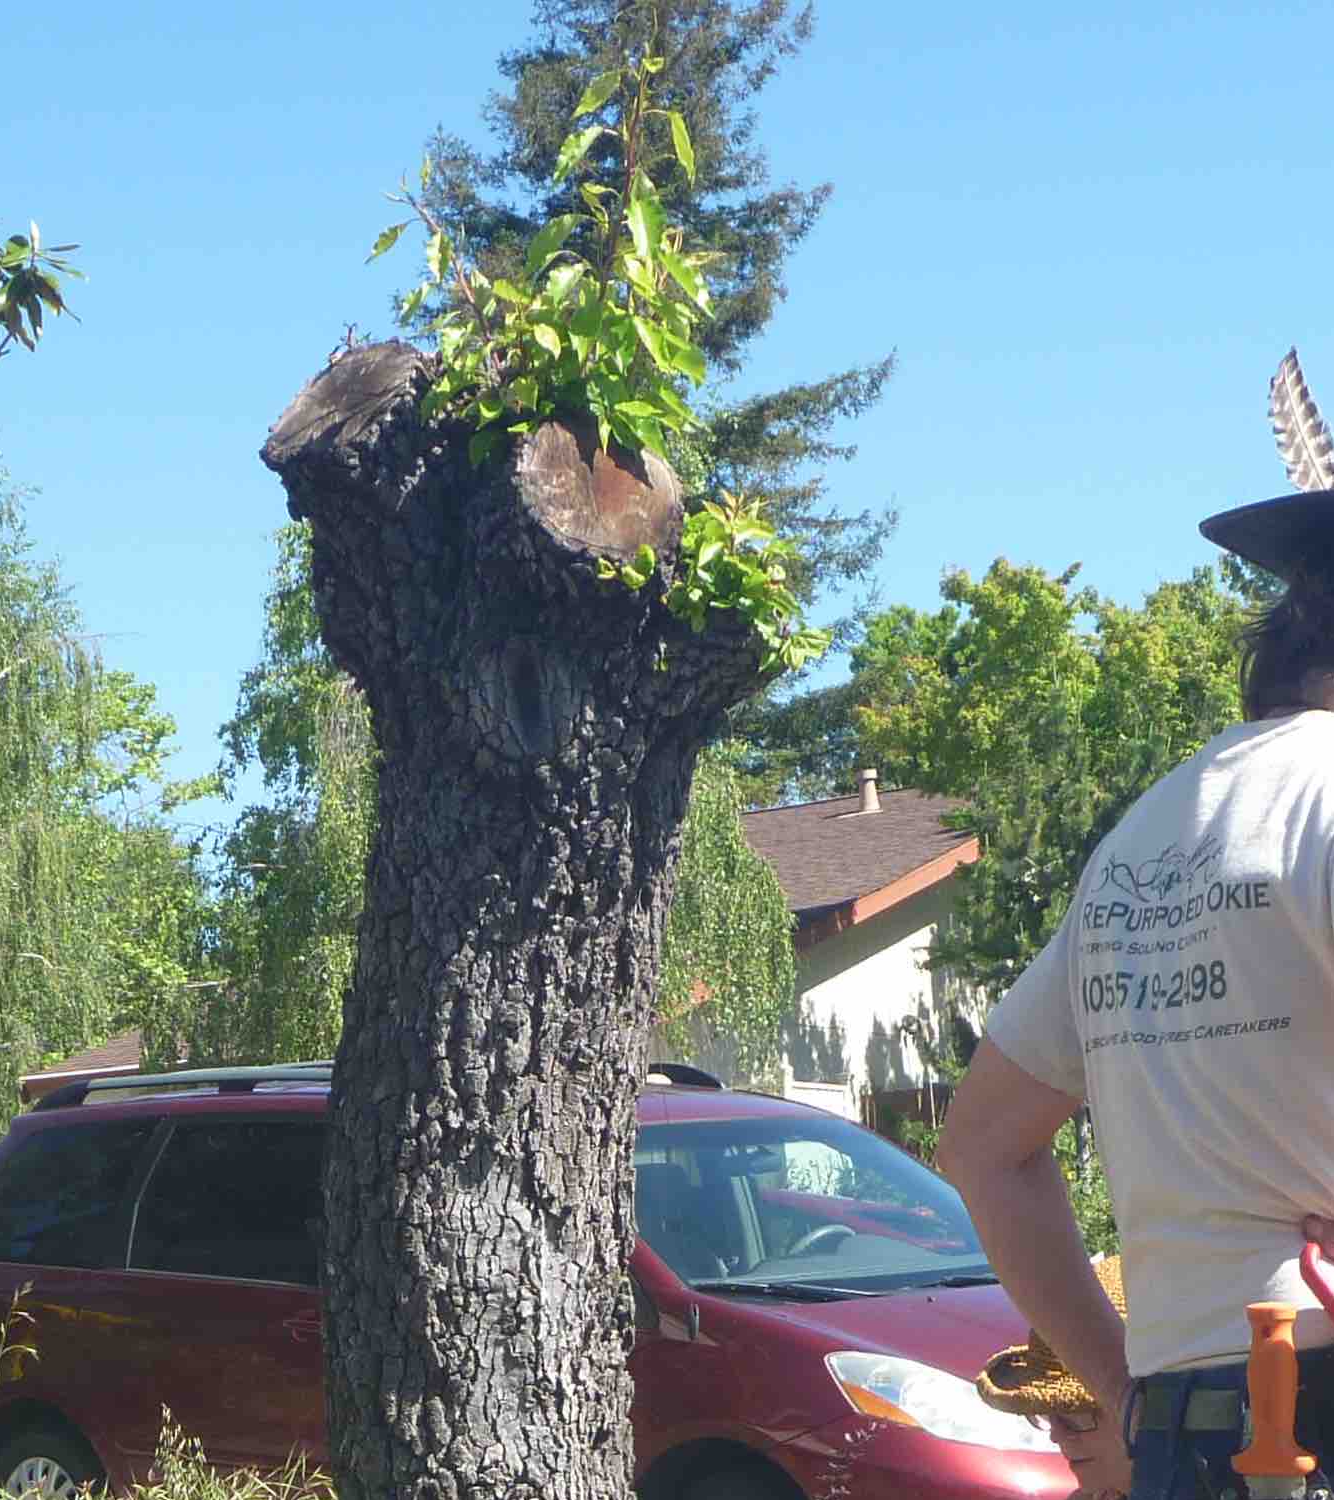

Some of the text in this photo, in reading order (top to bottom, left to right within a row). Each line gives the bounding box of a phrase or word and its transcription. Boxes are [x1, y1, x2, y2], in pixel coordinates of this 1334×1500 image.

[1082, 881, 1271, 932] REPURPOED OKIE
[1194, 1016, 1292, 1039] CARETAKERS
